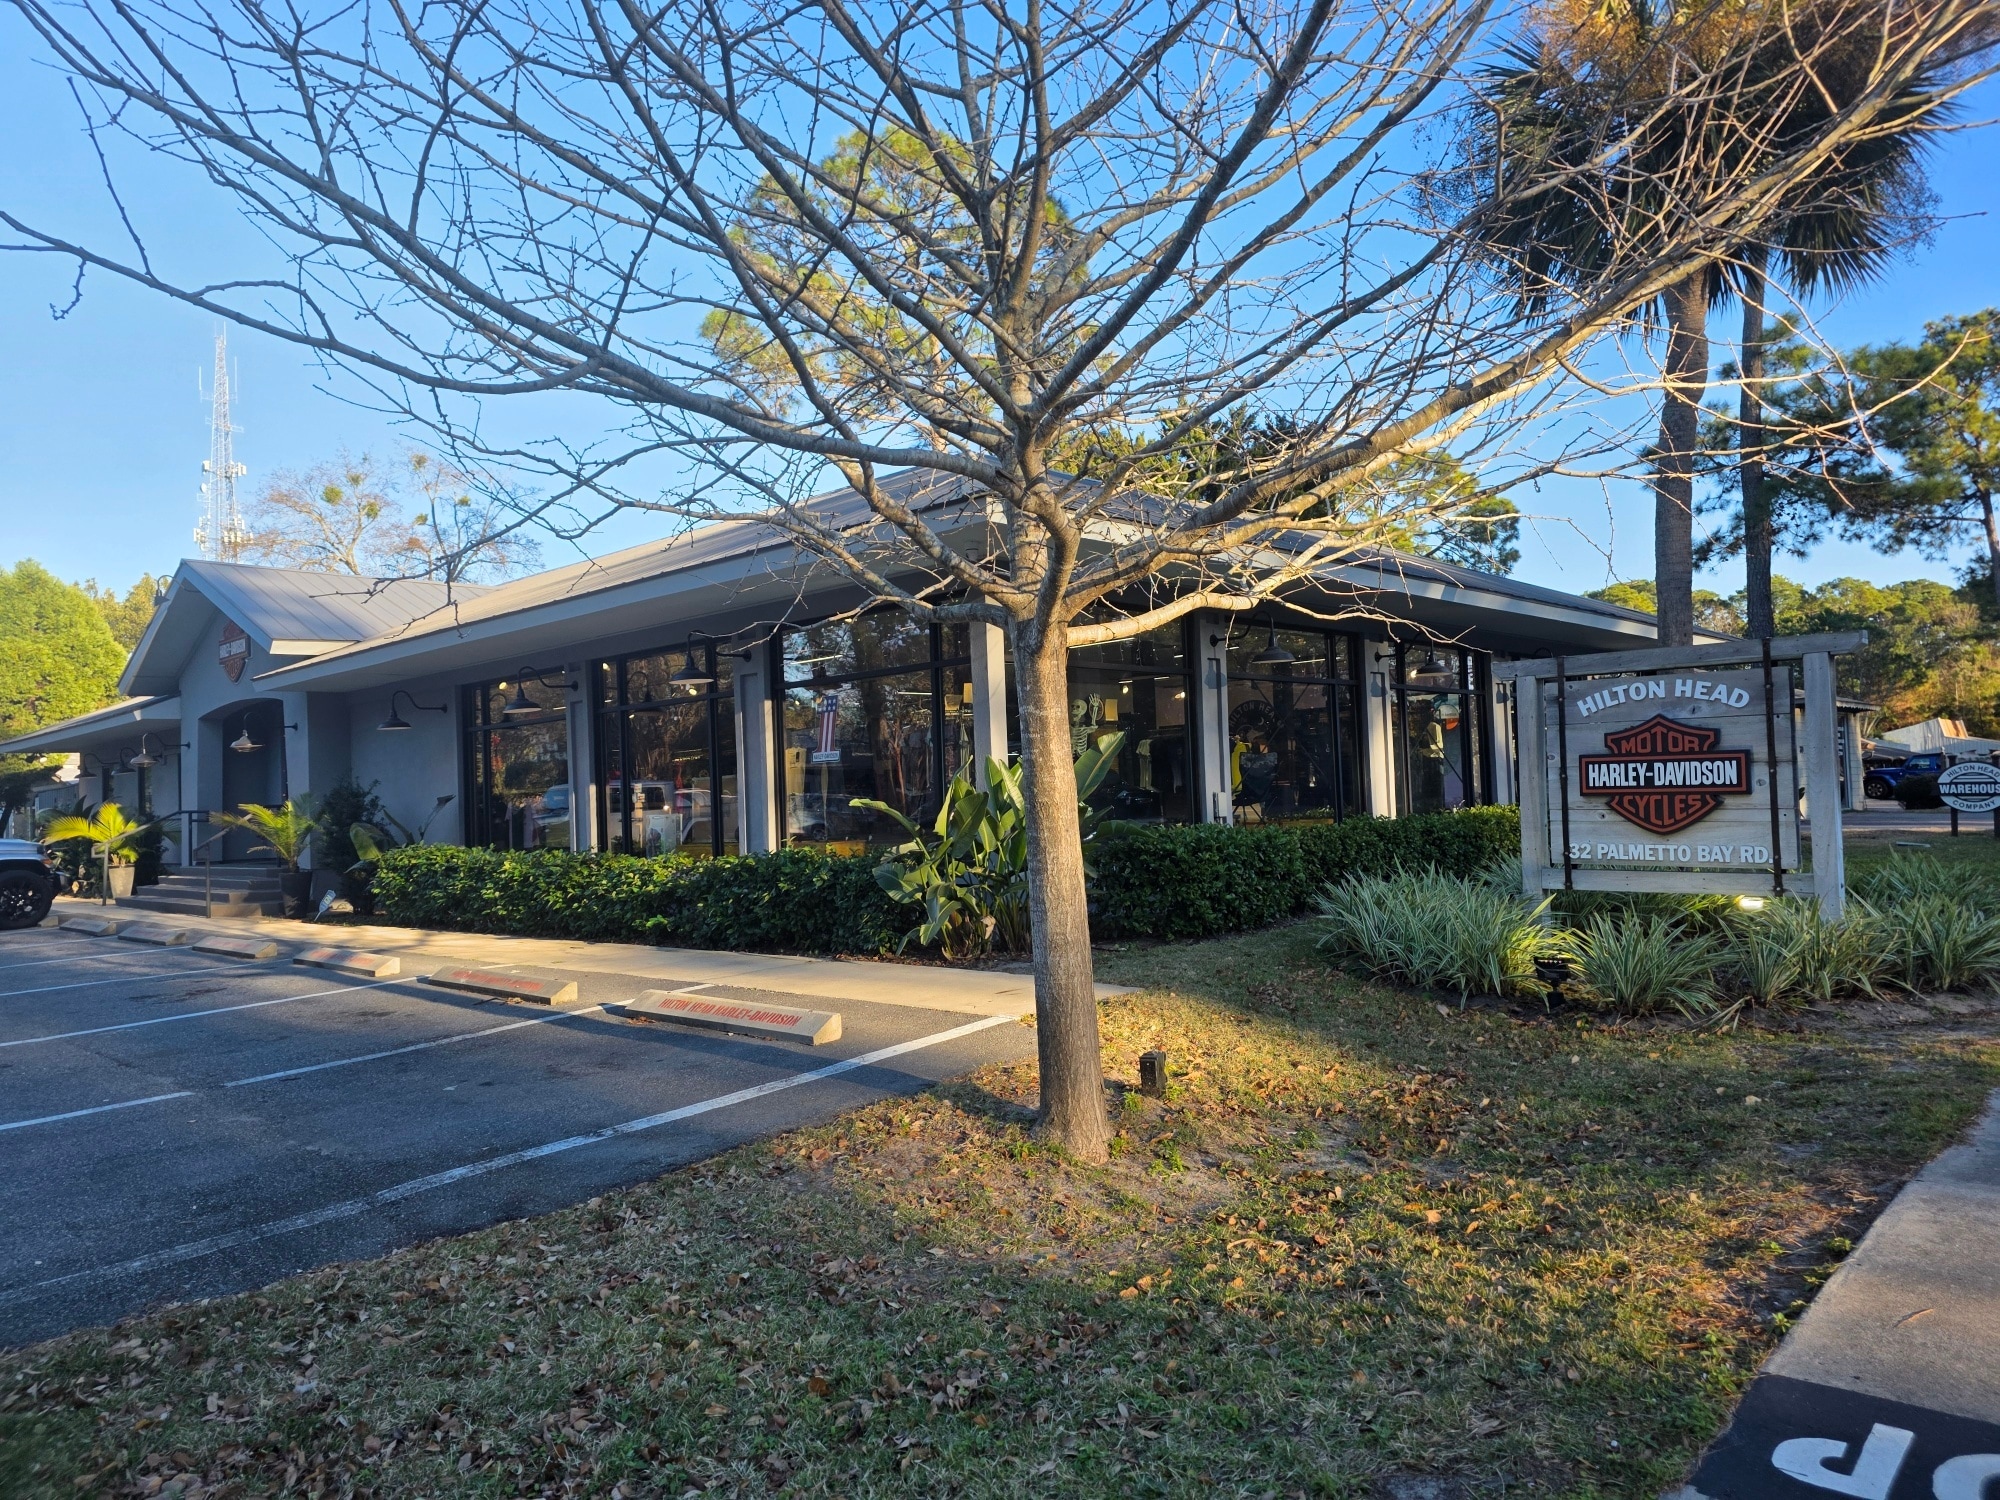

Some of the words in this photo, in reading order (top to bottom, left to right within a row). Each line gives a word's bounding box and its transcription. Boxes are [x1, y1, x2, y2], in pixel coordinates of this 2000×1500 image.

[1577, 680, 1665, 717] HILTON
[1675, 678, 1750, 708] HEAD
[1621, 725, 1700, 754] MOTOR
[1588, 760, 1738, 787] HARLEY-DAVIDSON
[1947, 765, 1975, 777] HILTON
[1977, 766, 2000, 777] HEAD
[1623, 794, 1702, 825] CYCLES
[1953, 800, 1995, 809] COMPANY
[1569, 843, 1591, 859] 32
[1597, 844, 1691, 862] PALMETTO
[1697, 845, 1735, 862] BAY
[1740, 846, 1773, 864] RD.
[658, 999, 691, 1011] HILTON
[687, 1002, 716, 1014] HEAD
[712, 1005, 802, 1027] HARLEY-DAVIDSON
